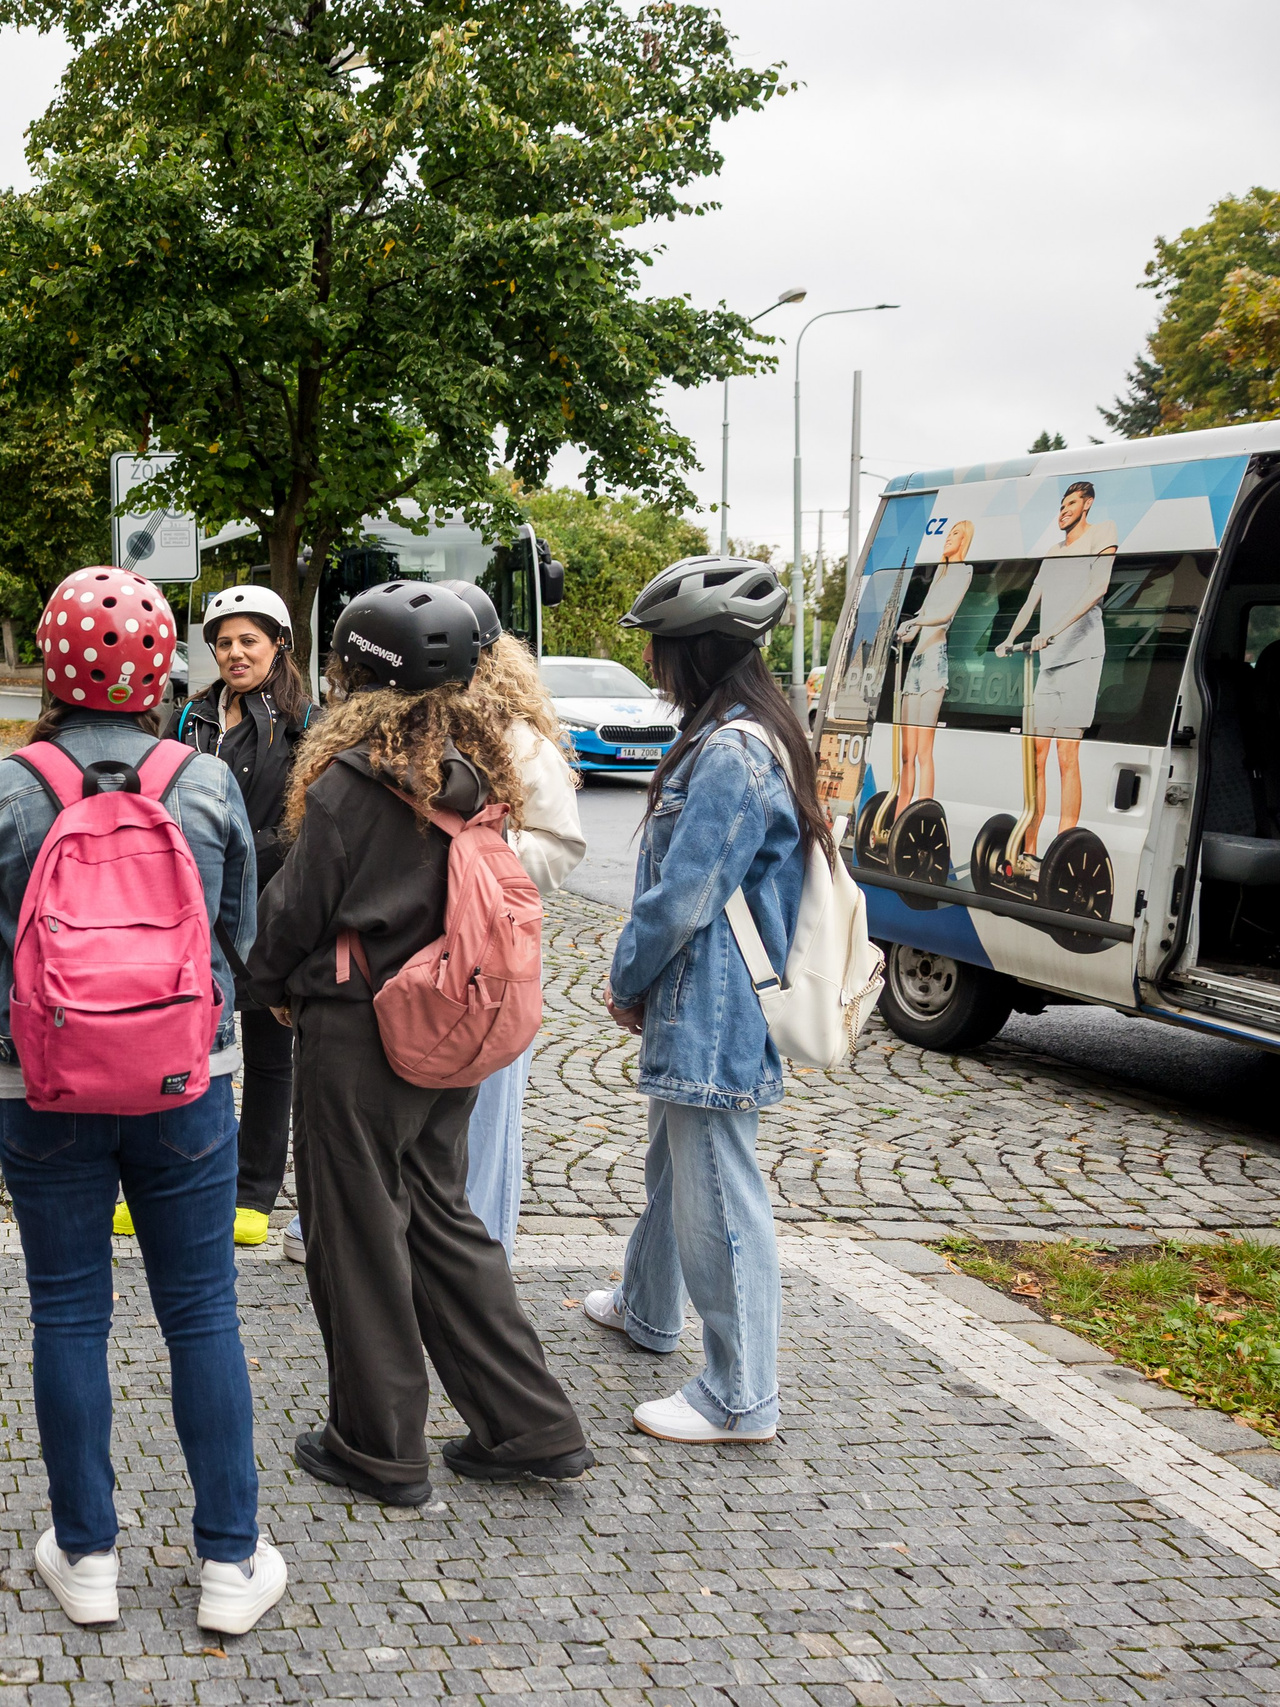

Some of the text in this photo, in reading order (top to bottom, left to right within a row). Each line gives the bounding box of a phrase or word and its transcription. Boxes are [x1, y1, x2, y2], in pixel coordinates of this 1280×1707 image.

[925, 517, 949, 536] CZ
[347, 630, 403, 667] pragueway.
[623, 749, 636, 757] 1AA
